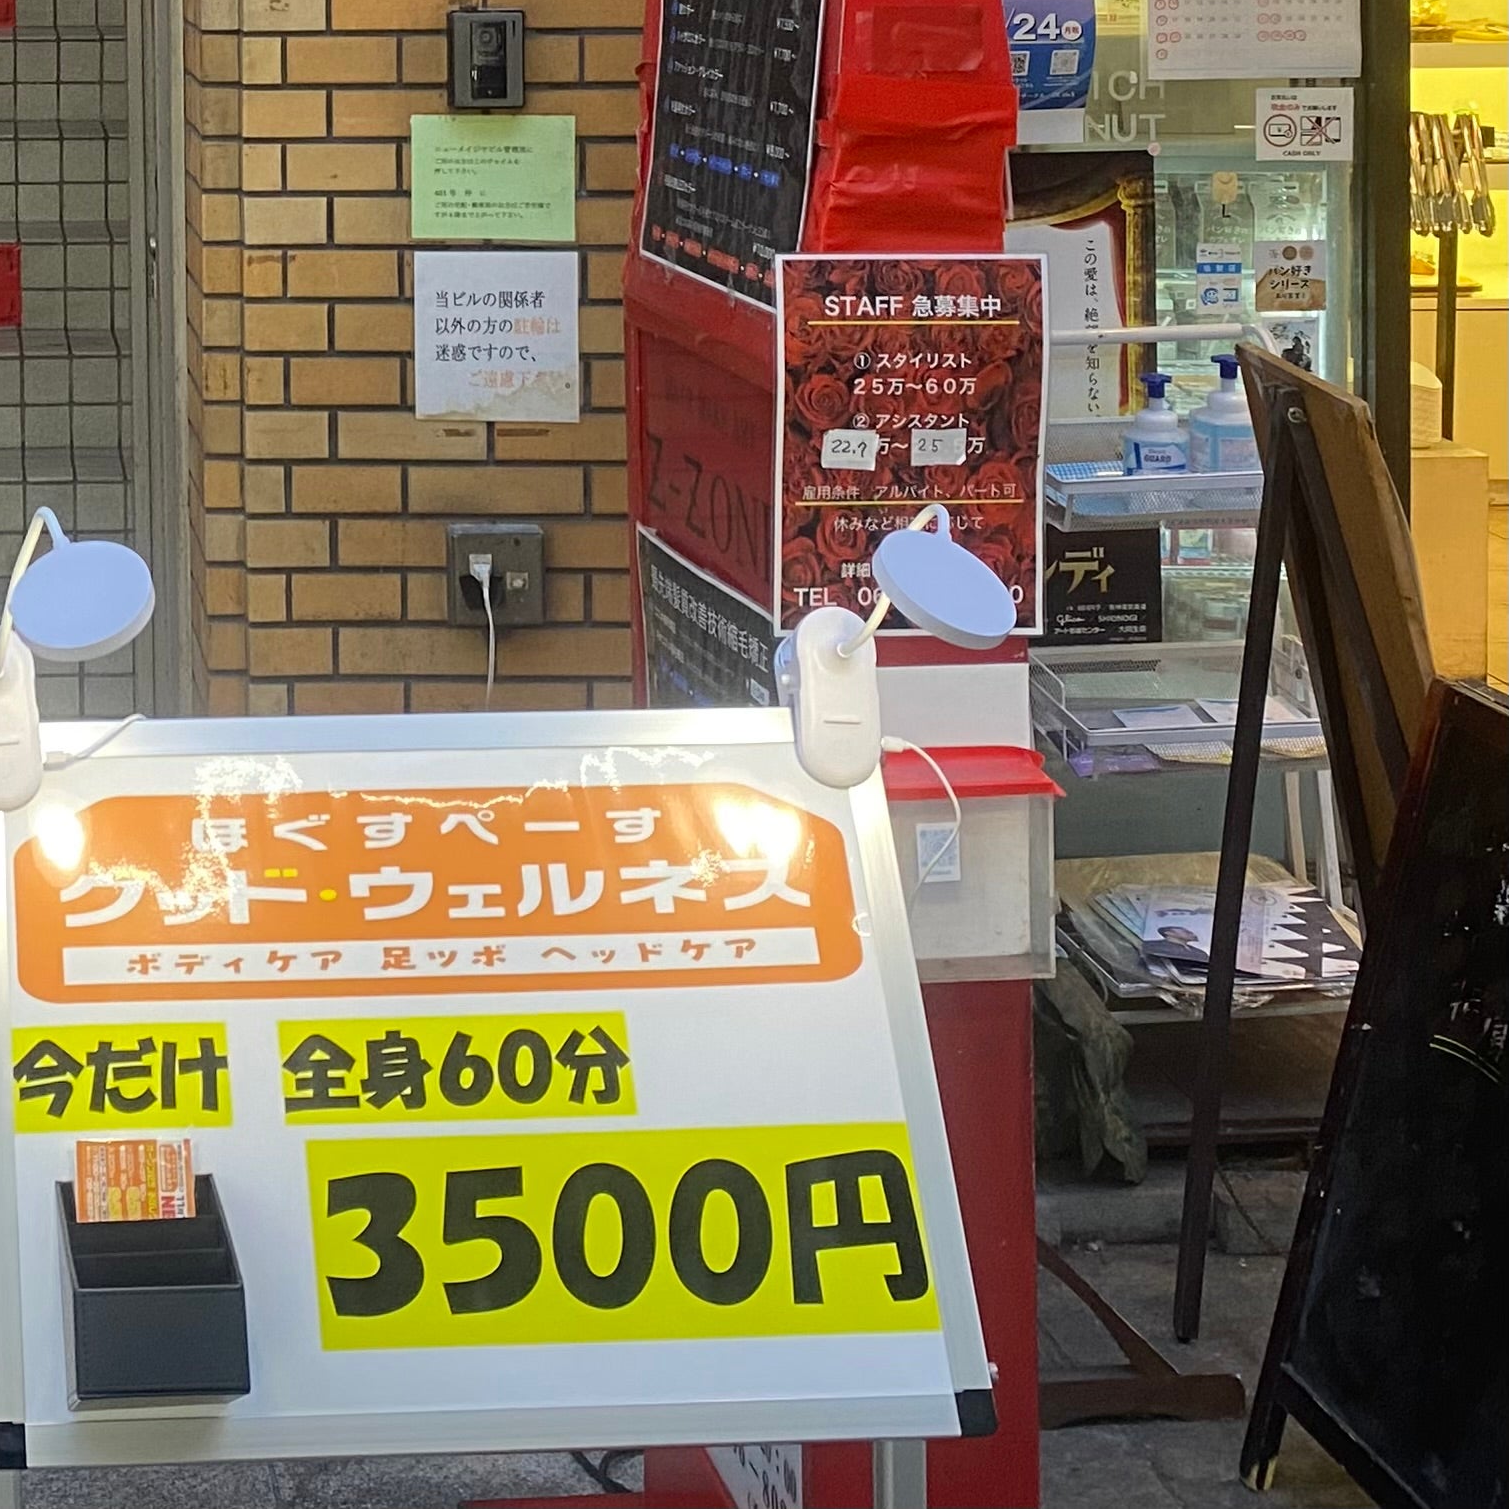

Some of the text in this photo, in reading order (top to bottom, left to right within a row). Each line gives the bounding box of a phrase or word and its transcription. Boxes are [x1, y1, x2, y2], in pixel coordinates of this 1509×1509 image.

[435, 291, 546, 309] 当ビルの関係者
[824, 294, 1002, 319] STAFF 急募集中
[435, 344, 538, 363] 迷惑ですので、
[877, 354, 972, 369] スタイリスト
[876, 413, 970, 429] アシスタント
[802, 485, 860, 501] 雇用条件
[834, 516, 985, 532] 休みなど相にじて
[793, 587, 837, 606] TEL
[192, 807, 662, 853] ほぐすぺーす
[126, 938, 759, 976] ボディケア 足ツボ ヘッドケア
[13, 1037, 229, 1117] 今だけ
[283, 1027, 631, 1114] 全身60分
[325, 1148, 931, 1319] 3500円
